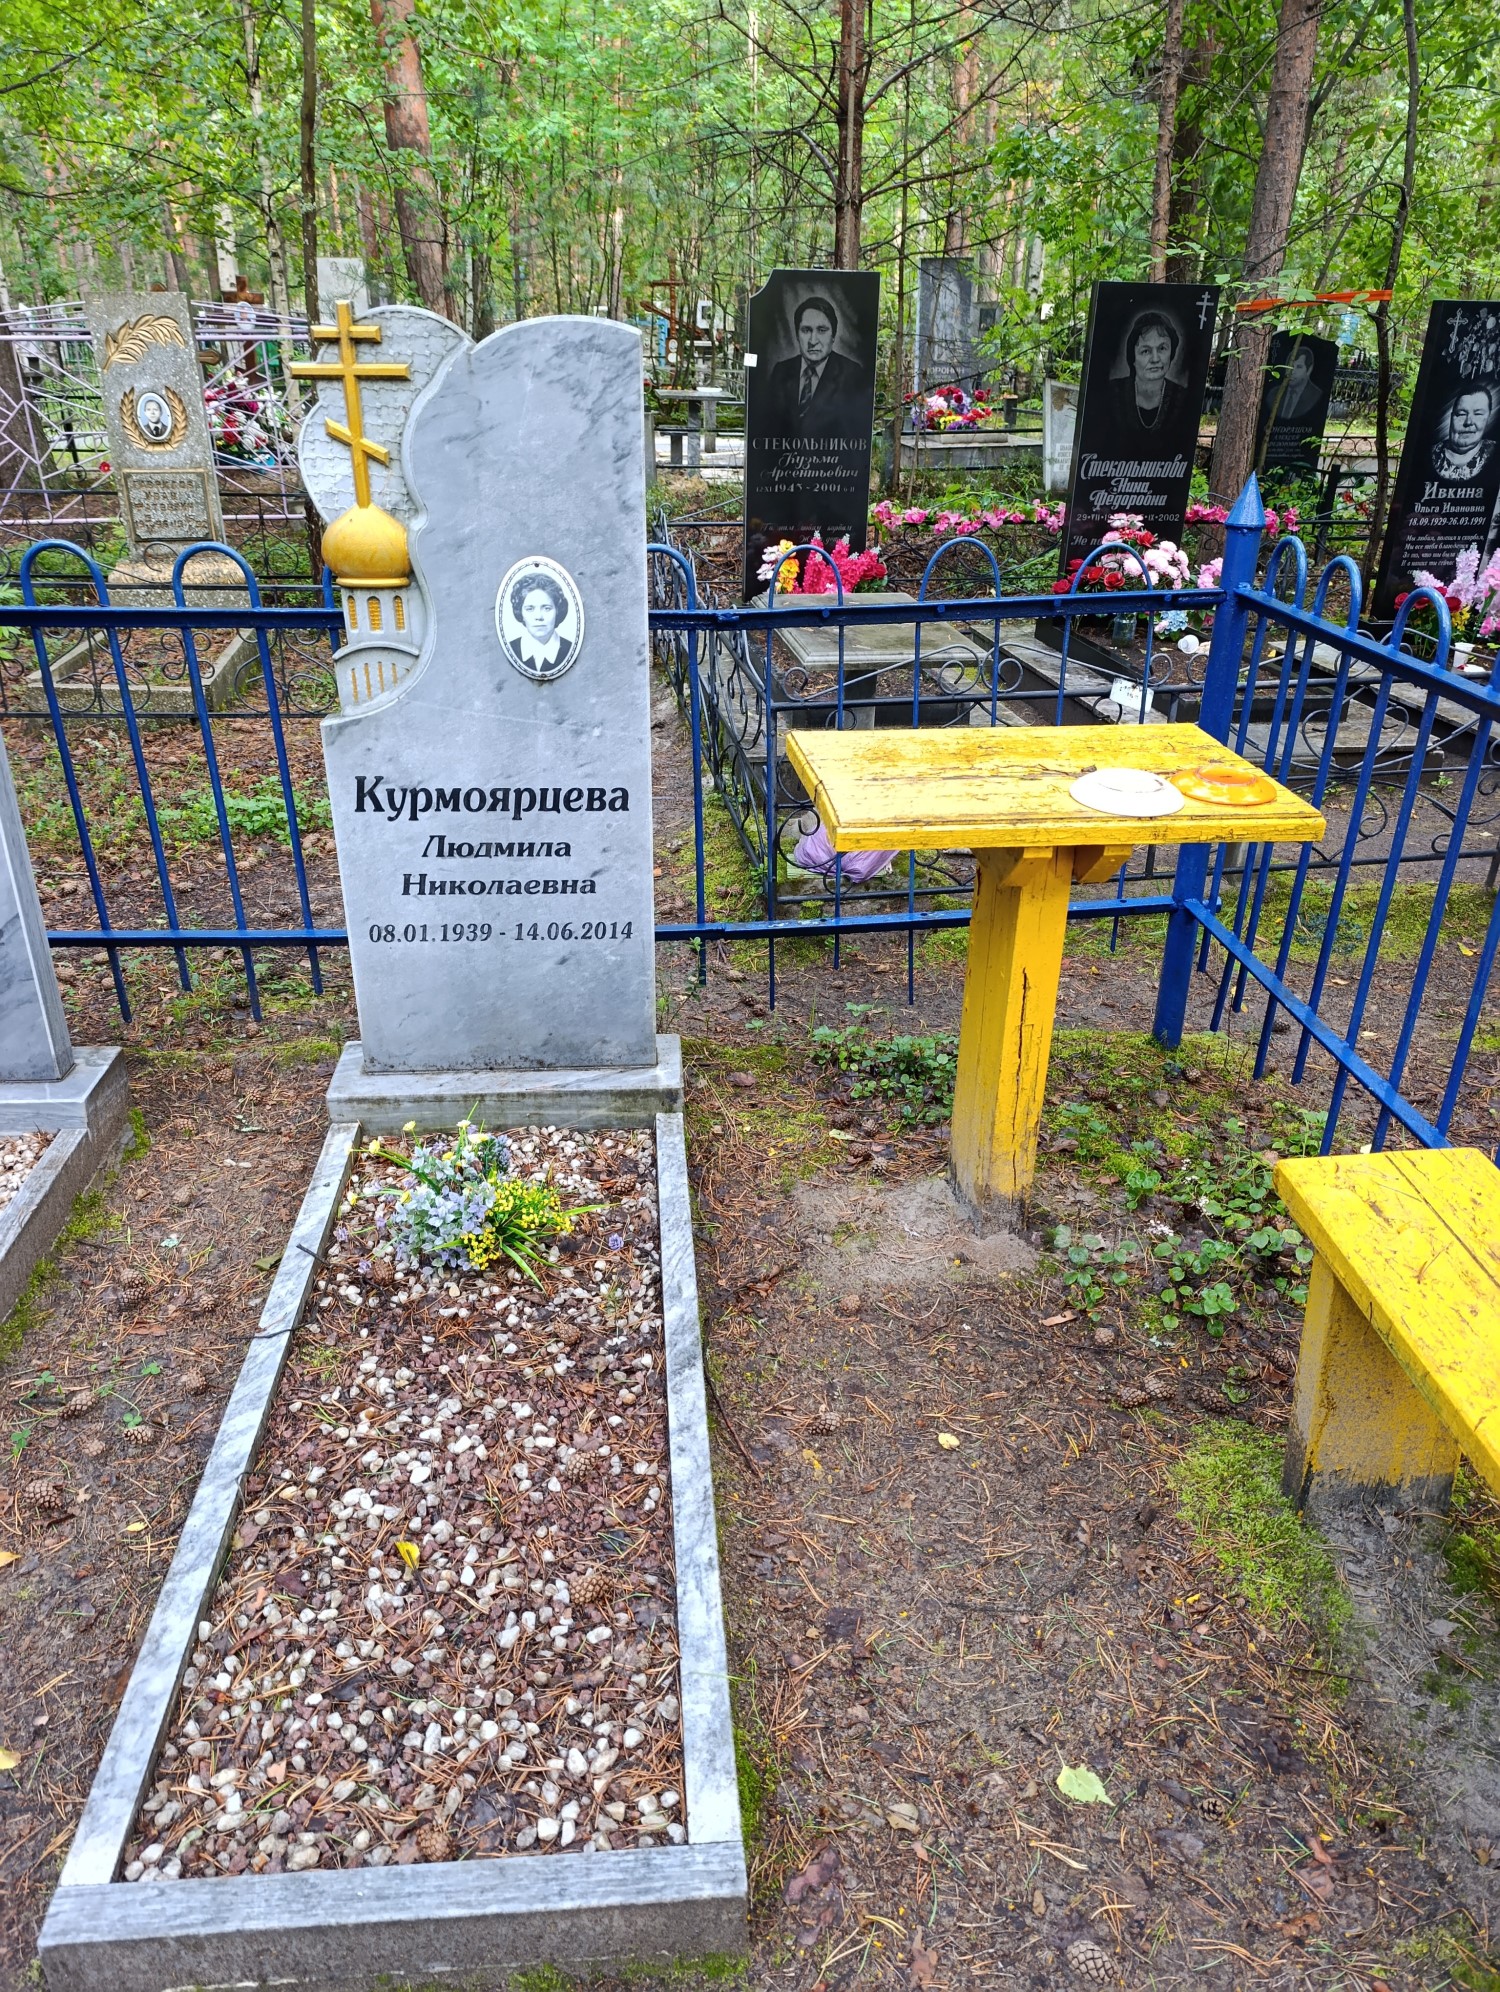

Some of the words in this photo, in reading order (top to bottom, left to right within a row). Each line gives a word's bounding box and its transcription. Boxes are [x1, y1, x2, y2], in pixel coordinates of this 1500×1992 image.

[752, 437, 867, 451] СТЕКОЛЬНИКОВ
[778, 451, 840, 470] Кузьма
[1080, 453, 1188, 480] Стекольникова
[760, 465, 859, 482] Арсентьевич
[1109, 477, 1151, 495] Нина
[1421, 481, 1484, 503] Ивкина
[1089, 488, 1168, 511] Федоровна
[1414, 502, 1440, 513] Ольга
[1441, 502, 1485, 514] Ивановна
[1071, 535, 1087, 546] Не
[354, 775, 630, 821] Курмоярцева
[421, 834, 572, 859] Людмила
[401, 873, 597, 896] Николаевна
[368, 923, 493, 943] 08.01.1939
[514, 921, 634, 942] 14.06.2014
